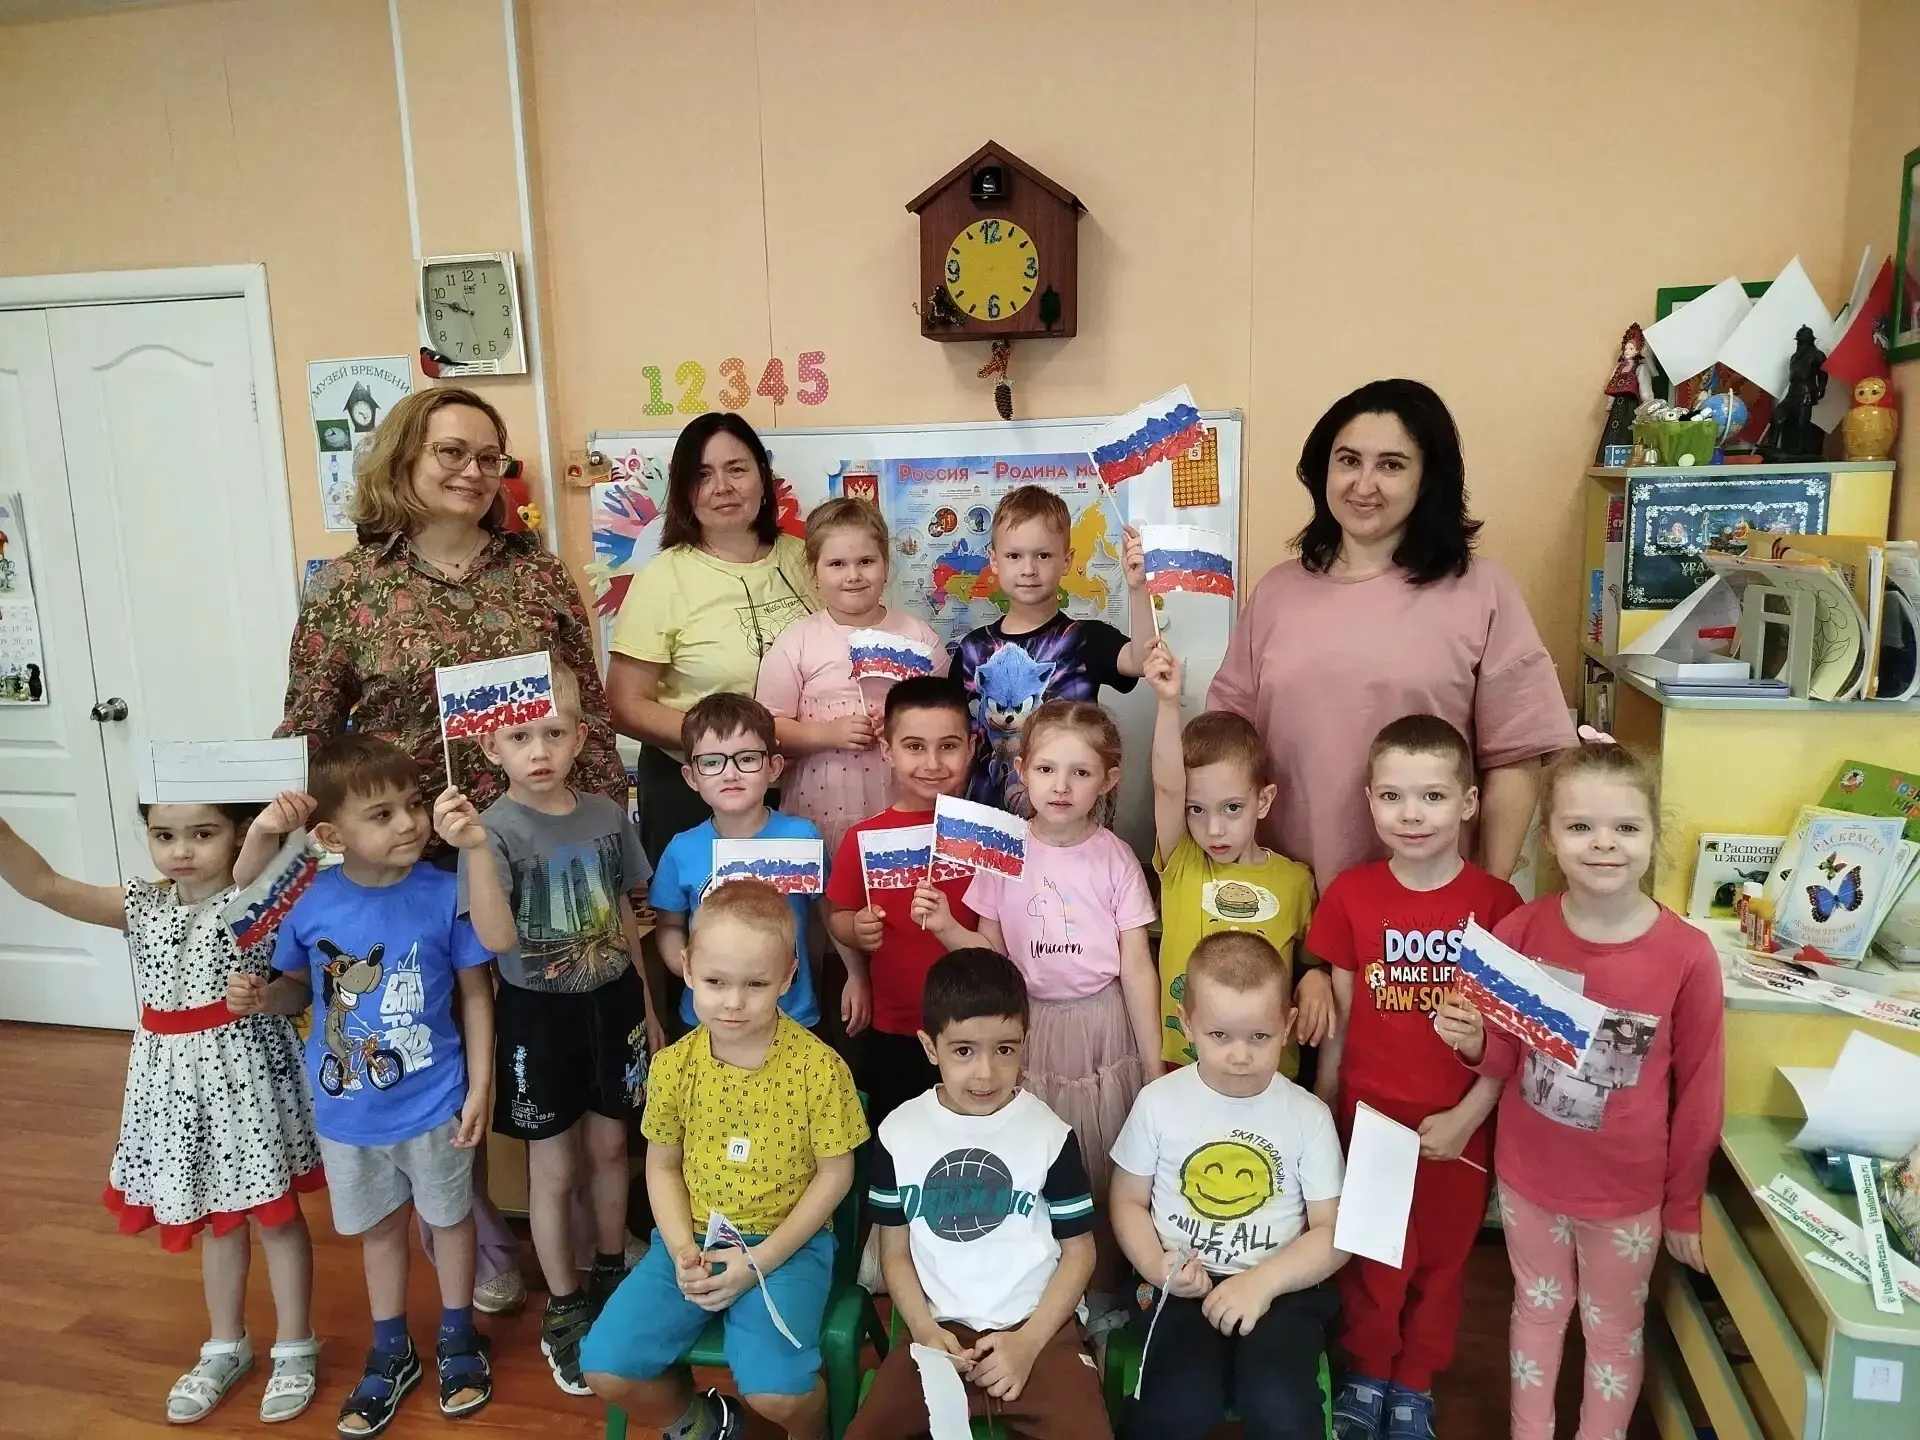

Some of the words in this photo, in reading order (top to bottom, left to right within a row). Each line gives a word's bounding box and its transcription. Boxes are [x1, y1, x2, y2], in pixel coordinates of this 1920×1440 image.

[979, 219, 1002, 245] 12
[946, 259, 960, 283] 9
[1023, 256, 1037, 279] 3
[446, 274, 456, 286] 11
[461, 269, 475, 282] 12
[481, 272, 487, 284] 1
[434, 287, 446, 299] 10
[498, 283, 506, 295] 2
[502, 305, 510, 317] 3
[987, 293, 1000, 318] 6
[435, 309, 443, 321] 9
[439, 330, 447, 342] 8
[503, 327, 510, 339] 4
[456, 342, 463, 353] 7
[472, 344, 480, 356] 6
[488, 340, 496, 352] 5
[312, 366, 348, 398] МУЗЕЙ
[350, 365, 410, 393] ВРЕМЕНИ
[641, 366, 674, 416] 1
[675, 361, 709, 413] 2
[718, 357, 751, 410] 3
[757, 357, 788, 406] 4
[797, 351, 829, 406] 5
[1191, 449, 1199, 458] 5
[1722, 842, 1782, 855] Растени
[1725, 854, 1778, 864] животн
[1030, 939, 1084, 959] Unicorn
[1385, 929, 1464, 963] DOGS
[1390, 966, 1429, 983] MAKE
[380, 971, 425, 1014] BORN
[384, 1023, 435, 1073] RIDE
[1230, 1221, 1279, 1253] ALL
